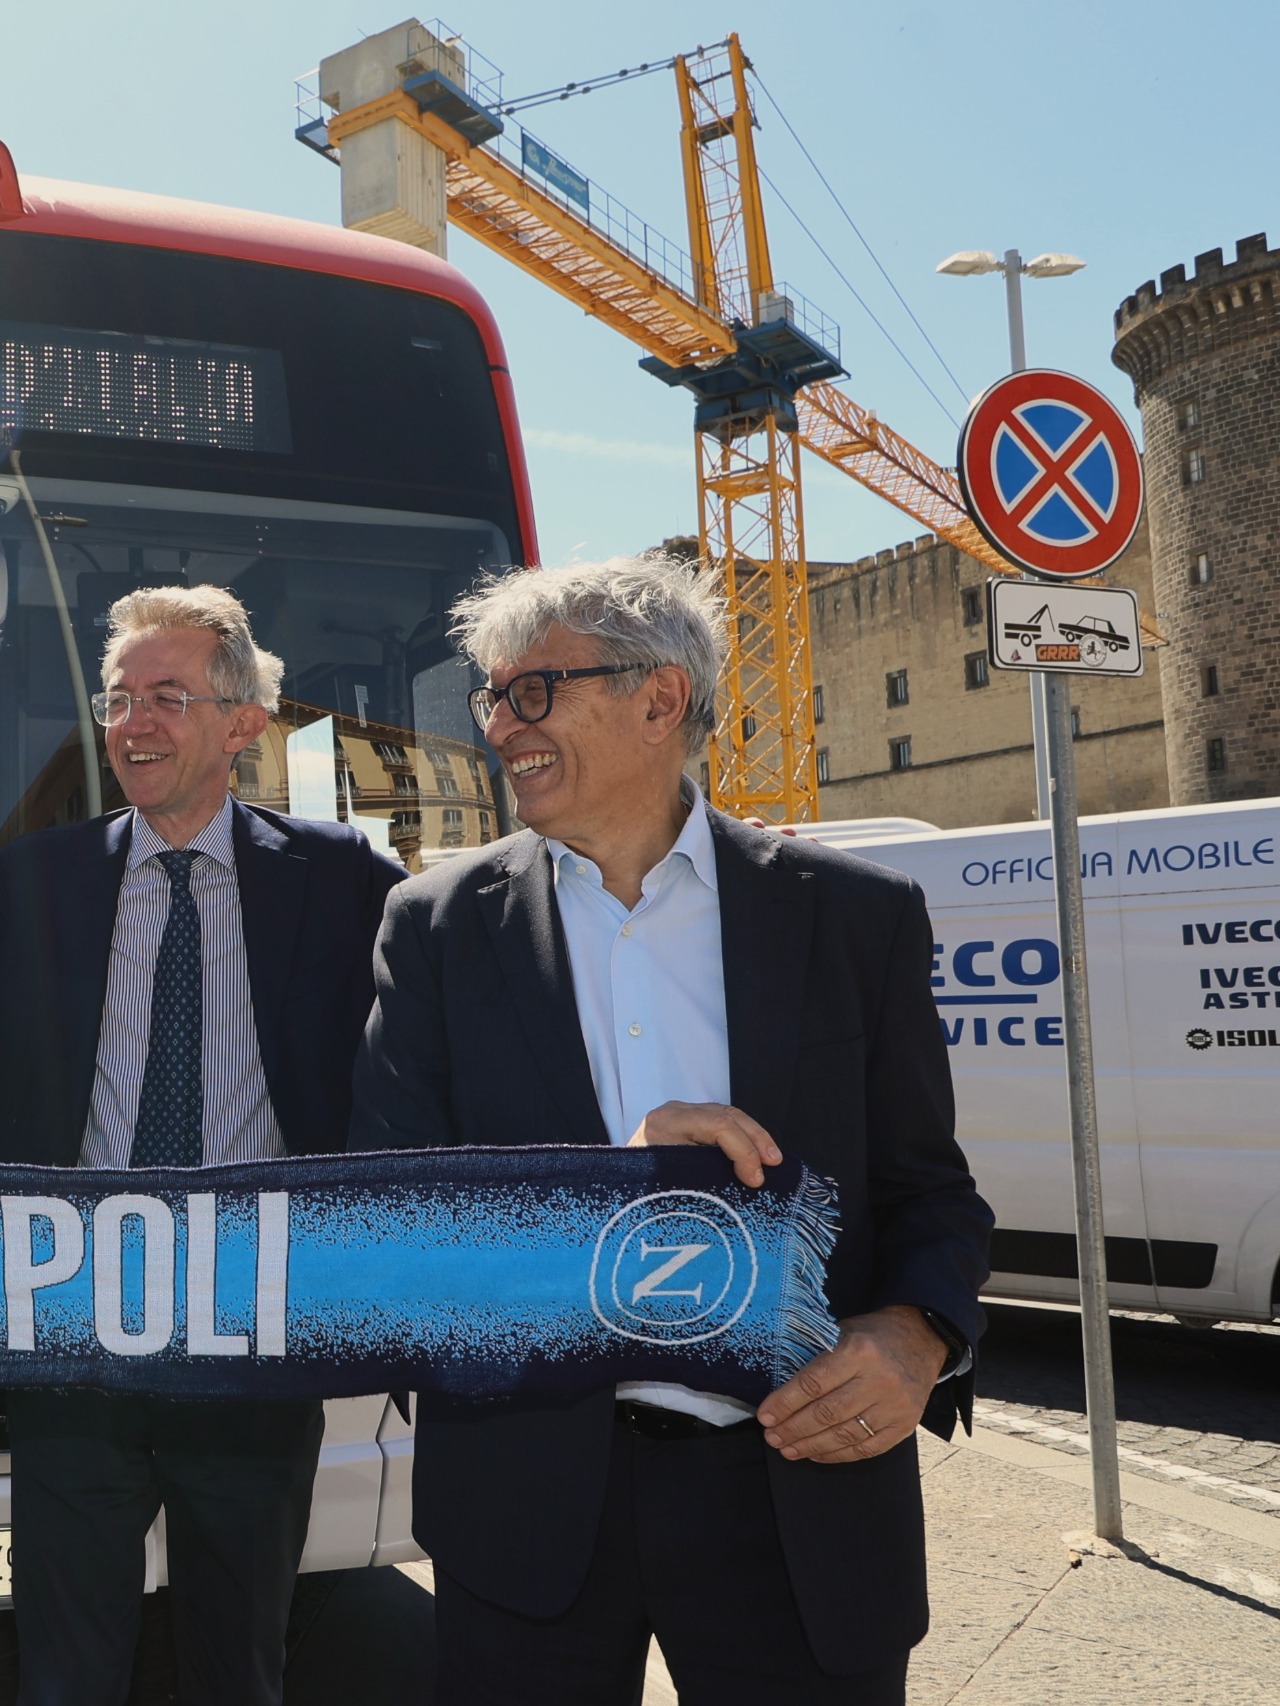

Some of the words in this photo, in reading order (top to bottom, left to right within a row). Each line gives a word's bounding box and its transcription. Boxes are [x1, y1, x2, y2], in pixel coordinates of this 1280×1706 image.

[1037, 645, 1079, 660] GRRR
[962, 851, 1113, 886] OFFICA
[1126, 838, 1274, 875] MOBILE
[1182, 919, 1280, 945] IVEC
